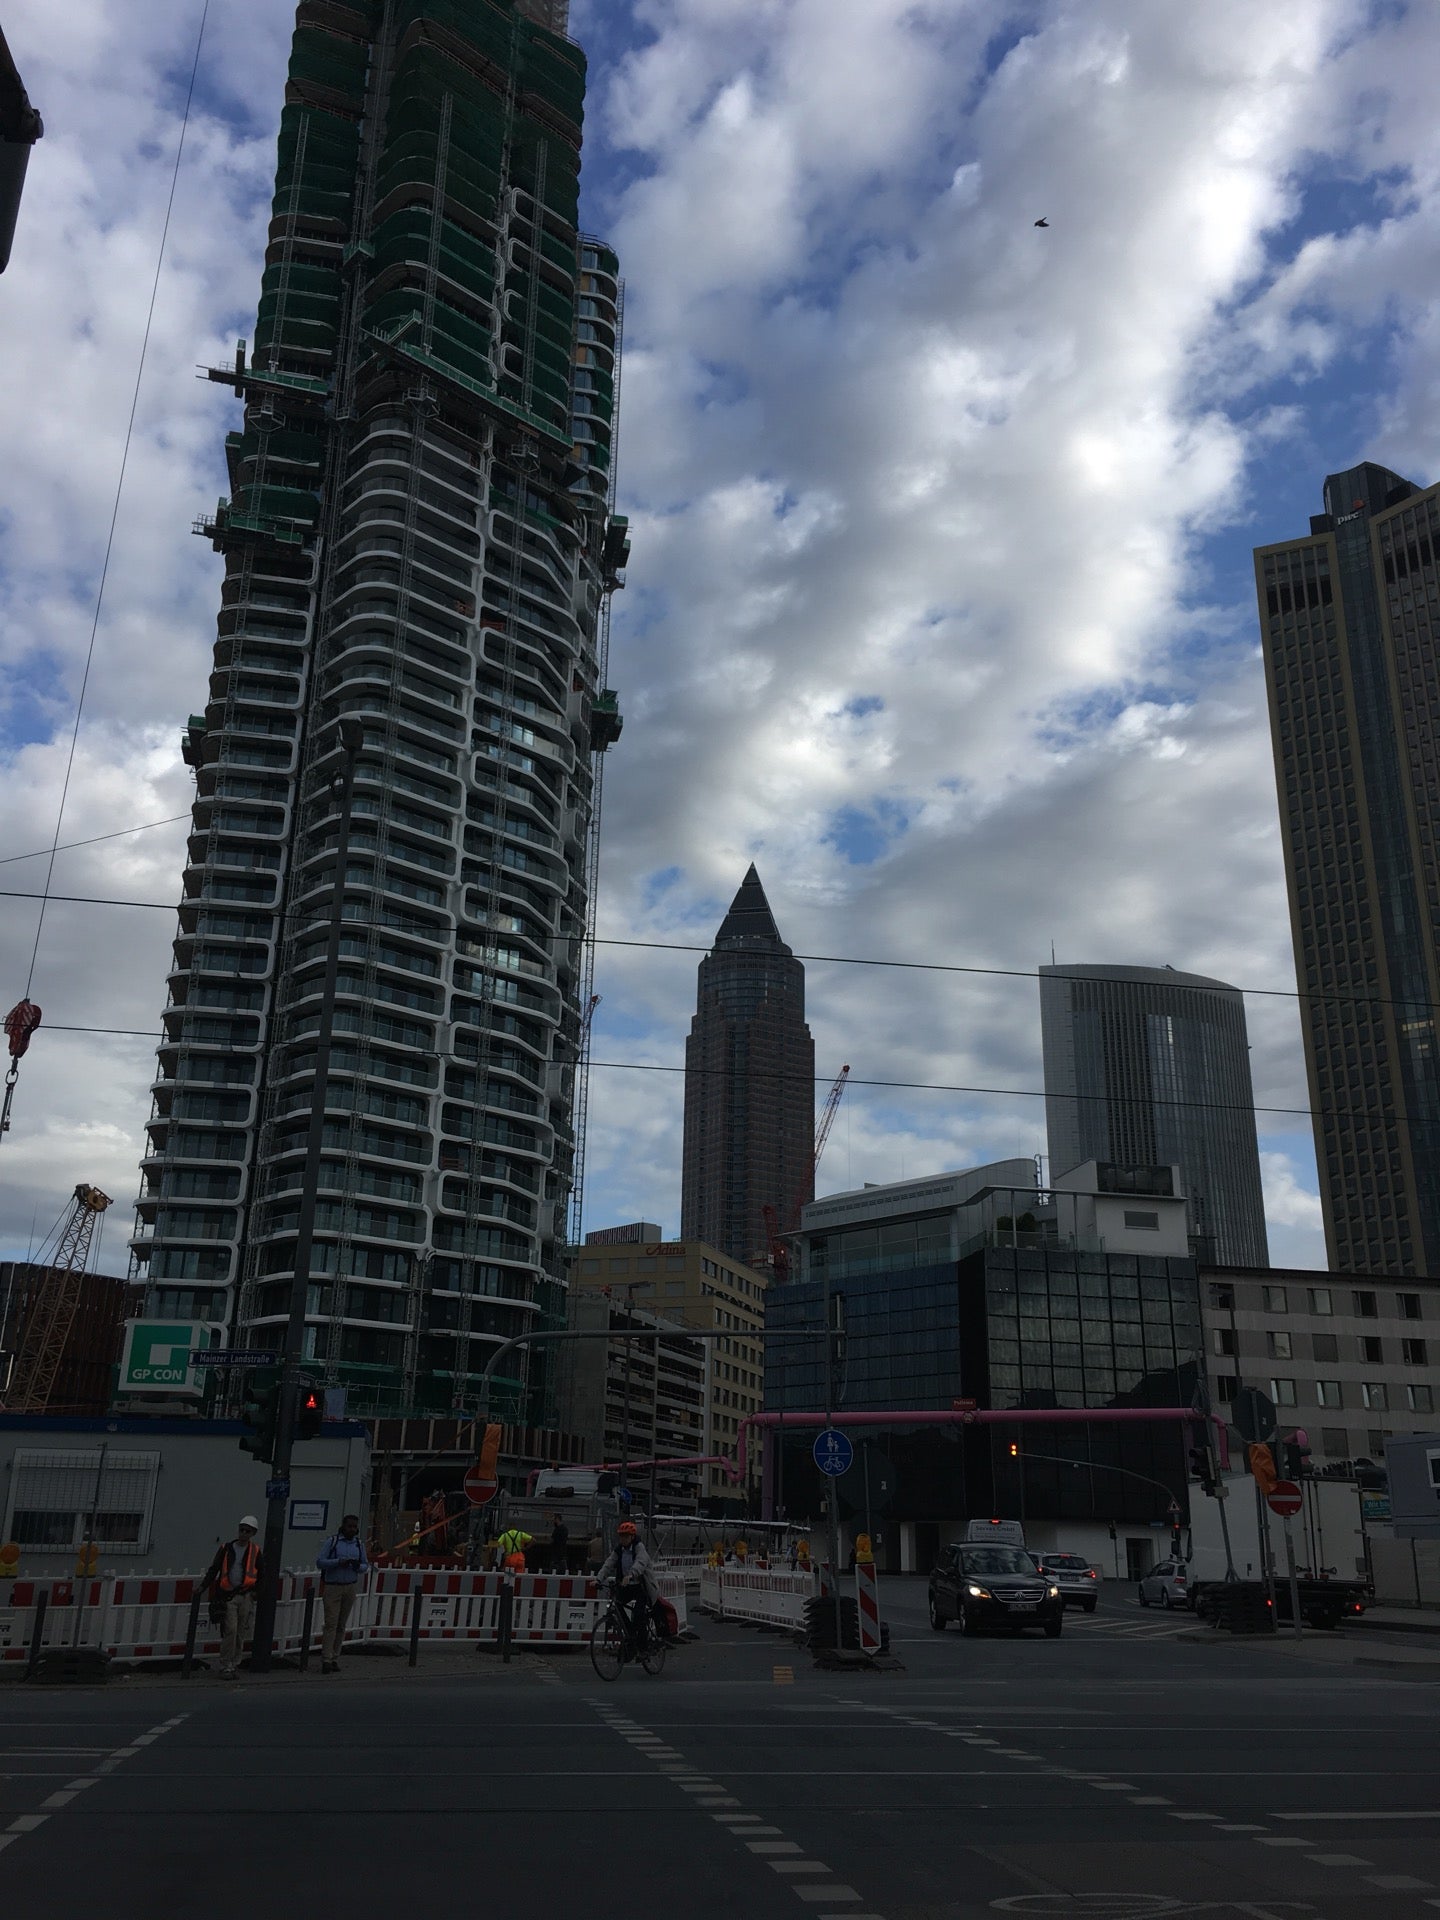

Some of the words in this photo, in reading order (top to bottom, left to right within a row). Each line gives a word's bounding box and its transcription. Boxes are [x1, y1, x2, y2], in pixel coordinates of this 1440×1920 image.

[1337, 511, 1360, 525] pwc
[646, 1243, 686, 1256] Adina
[199, 1353, 228, 1363] Mainzer
[230, 1354, 270, 1364] Landstraße
[132, 1368, 151, 1380] GP
[153, 1368, 183, 1380] CON
[431, 1608, 447, 1616] FFR
